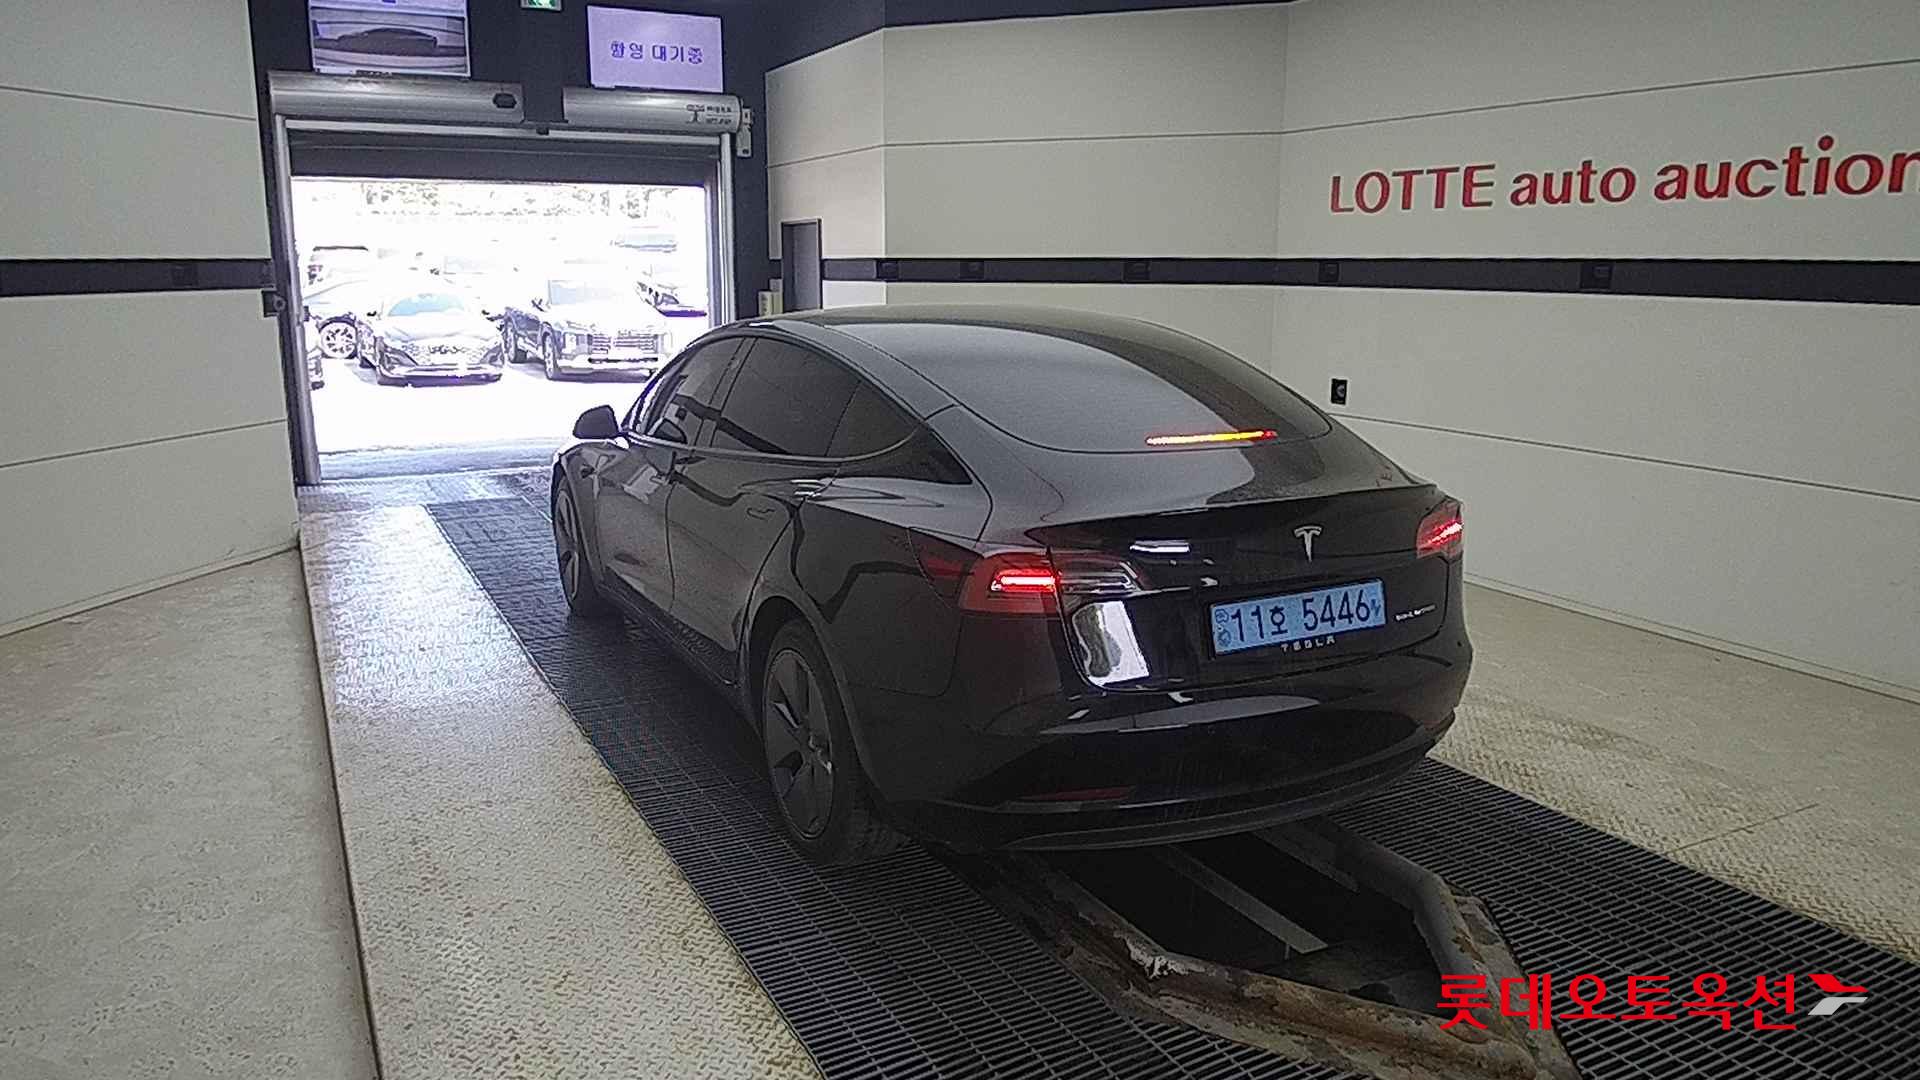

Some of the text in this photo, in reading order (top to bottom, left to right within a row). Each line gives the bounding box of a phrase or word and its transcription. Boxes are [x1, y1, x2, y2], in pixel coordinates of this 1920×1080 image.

[652, 44, 703, 65] 대기중
[1330, 164, 1496, 214] LOTTE
[1510, 160, 1636, 206] auto
[1230, 605, 1288, 643] 11호
[1302, 589, 1370, 632] 5446
